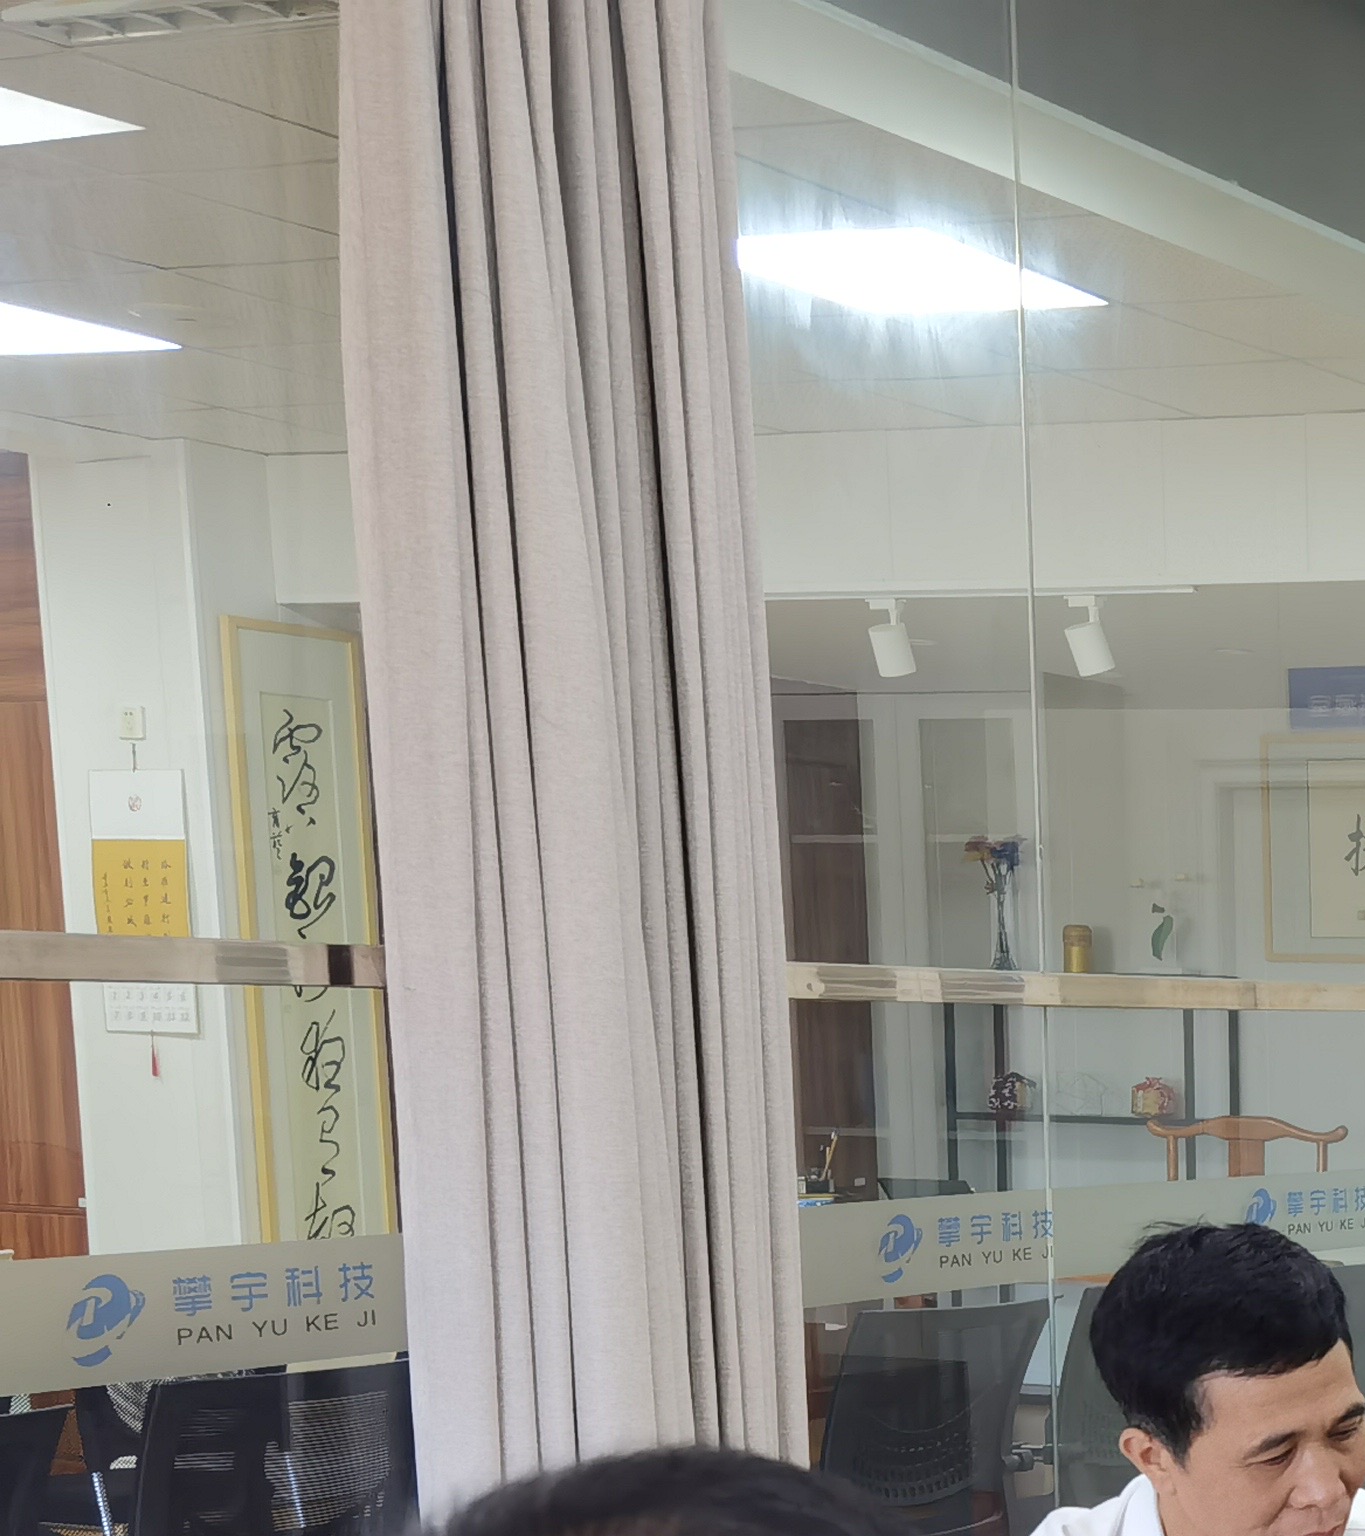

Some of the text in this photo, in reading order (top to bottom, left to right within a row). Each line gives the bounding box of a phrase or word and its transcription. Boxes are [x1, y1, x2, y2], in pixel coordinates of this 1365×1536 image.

[1287, 1222, 1312, 1236] PAN
[1318, 1220, 1334, 1233] YU
[1340, 1218, 1354, 1230] KE
[940, 1244, 1053, 1269] PAN YU KE JI
[172, 1262, 375, 1317] 攀宇科技
[177, 1309, 377, 1346] PAN YU KE JI
